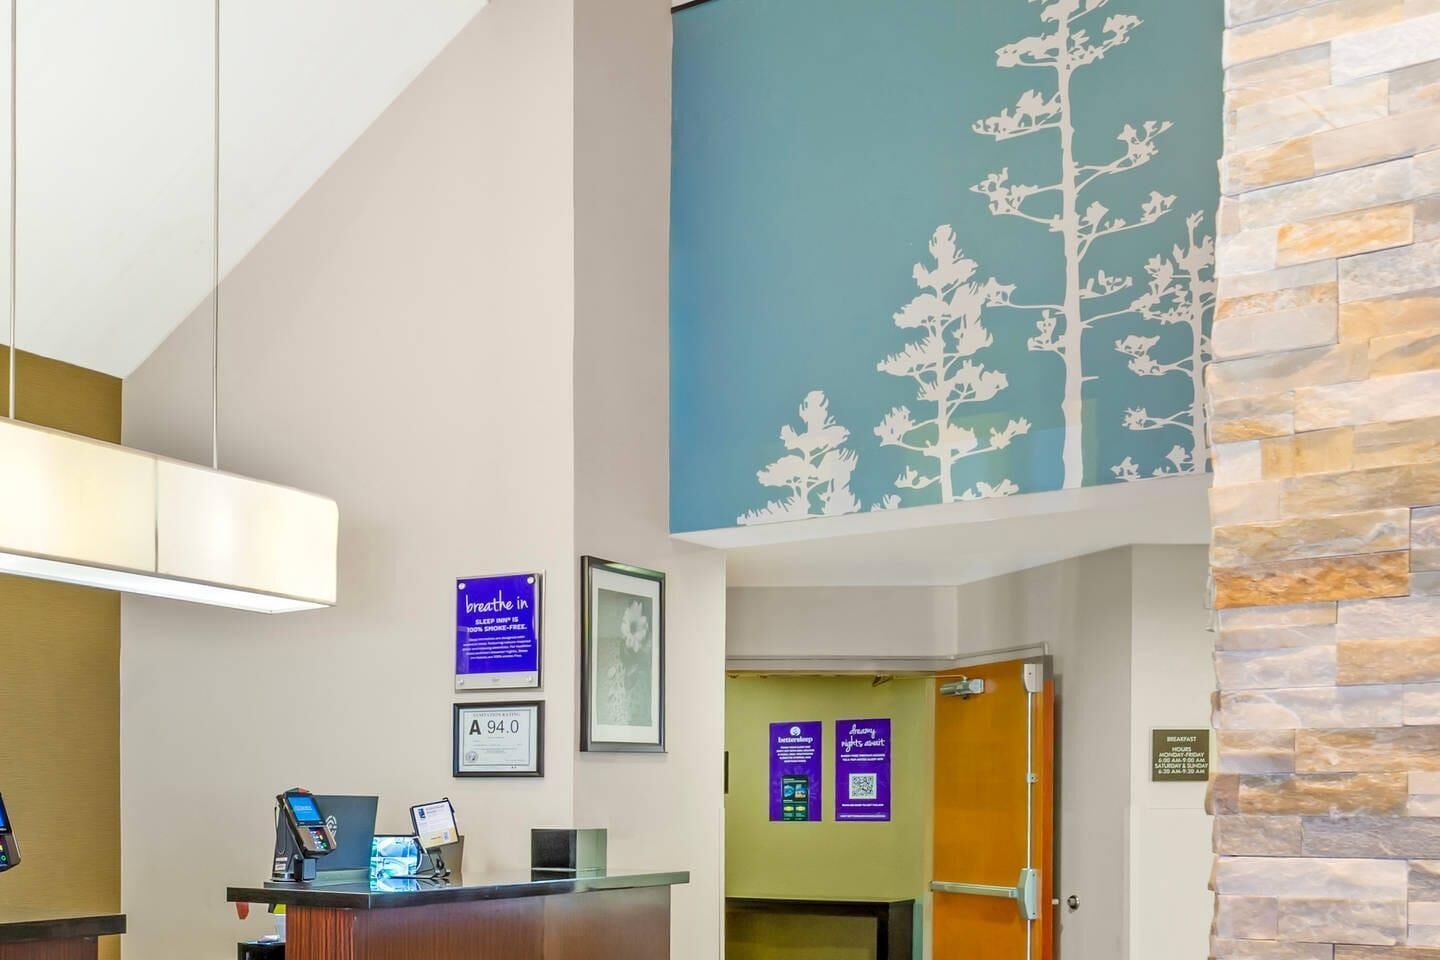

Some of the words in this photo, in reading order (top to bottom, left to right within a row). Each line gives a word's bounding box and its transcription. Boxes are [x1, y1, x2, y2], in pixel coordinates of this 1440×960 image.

[465, 589, 514, 614] breathe
[517, 596, 529, 610] in
[469, 719, 482, 736] A
[487, 719, 519, 735] 94.0
[849, 723, 876, 739] dreamy
[841, 735, 863, 753] nights
[864, 738, 886, 747] await
